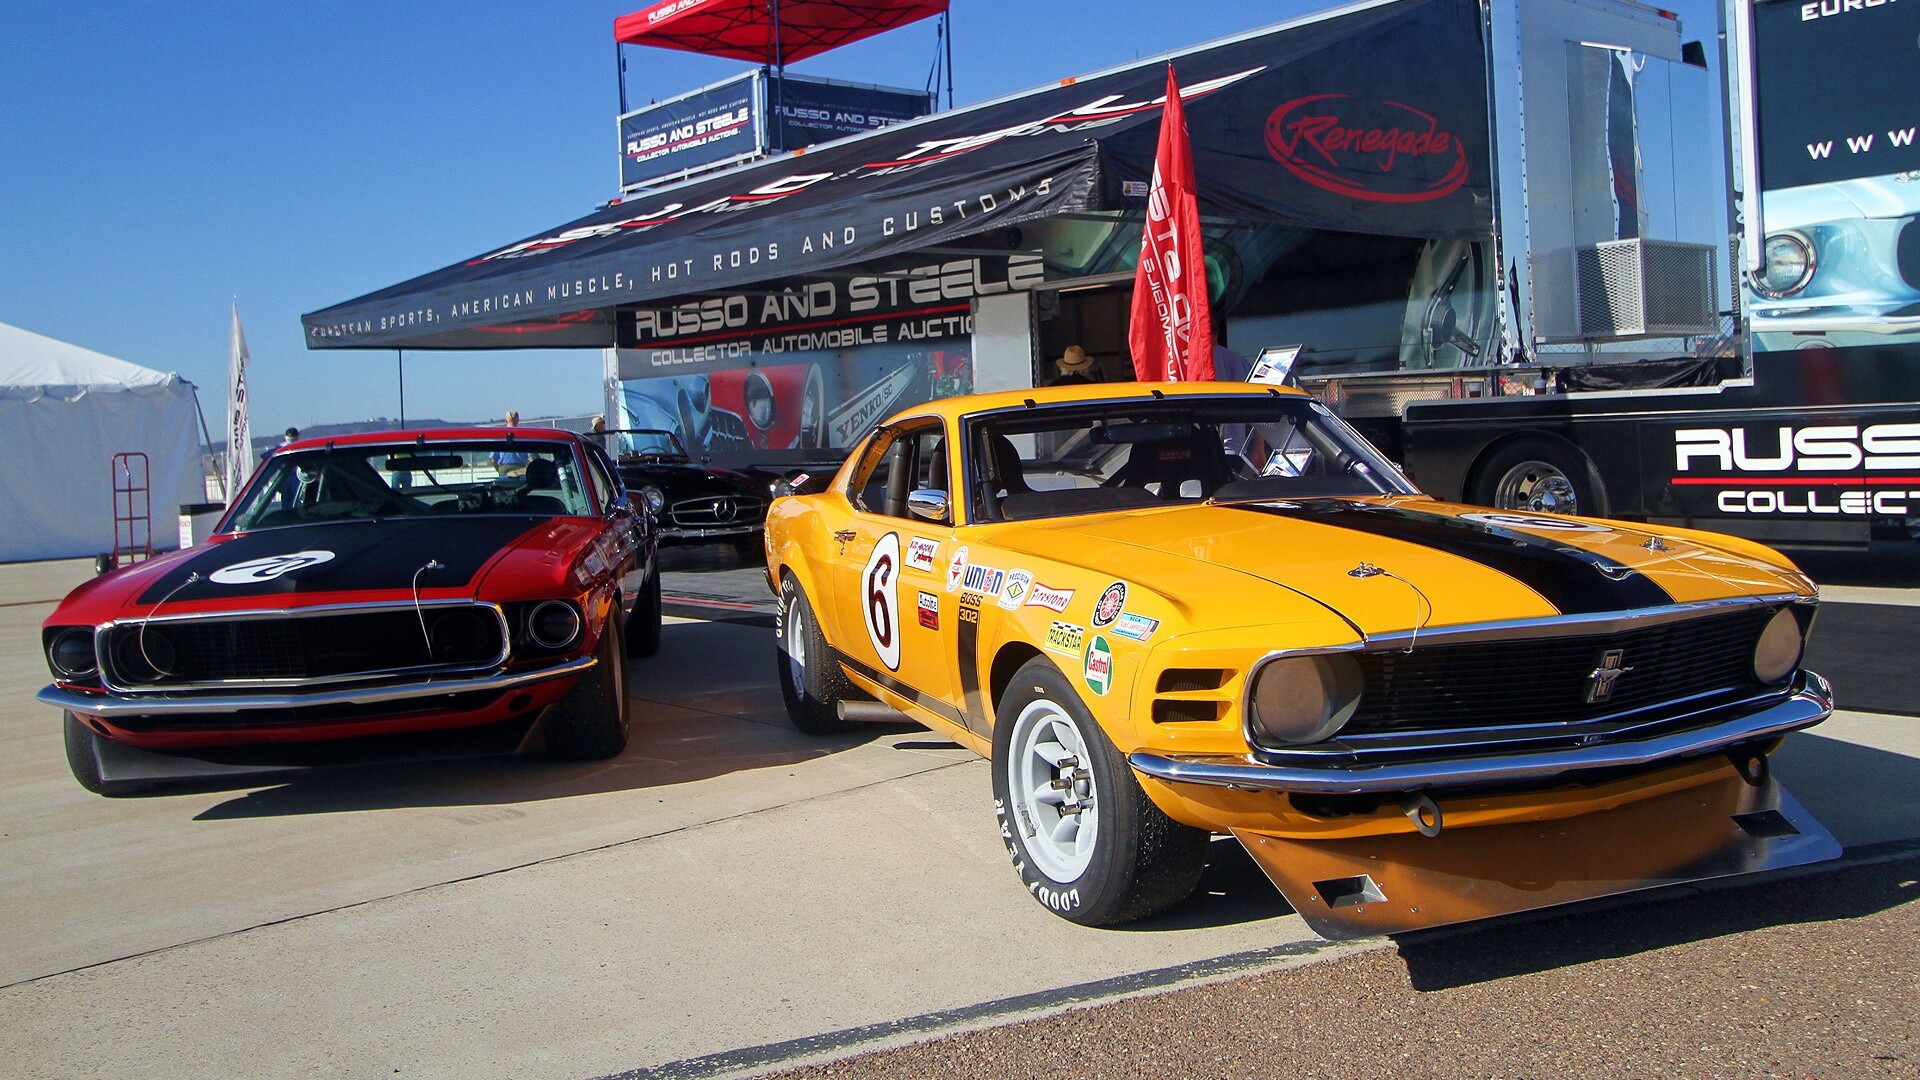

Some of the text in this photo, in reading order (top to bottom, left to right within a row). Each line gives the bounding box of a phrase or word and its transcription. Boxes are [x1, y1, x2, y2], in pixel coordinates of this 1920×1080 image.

[1801, 0, 1901, 22] EUR
[775, 104, 830, 121] RUSSO
[835, 112, 865, 124] AND
[788, 120, 833, 130] COLLECTOR
[627, 132, 667, 155] RUSSO
[669, 125, 694, 143] AND
[696, 107, 749, 136] STEELE
[1286, 115, 1450, 172] Renegade
[636, 148, 670, 163] COLLECTOR
[671, 137, 707, 154] AUTOMOBILE
[381, 310, 441, 331] SPORTS,
[451, 290, 533, 318] AMERICAN
[548, 272, 634, 301] MUSCLE,
[651, 259, 693, 282] HOT
[713, 243, 778, 271] RODS
[803, 226, 856, 254] AND
[883, 178, 1053, 236] CUSTOMS
[635, 250, 1045, 340] RUSSO AND STEELE
[651, 341, 752, 367] COLLECTOR
[762, 325, 888, 355] AUTOMOBILE
[1675, 423, 1920, 471] RUSS
[868, 553, 892, 649] 6
[960, 592, 984, 607] BOSS
[1030, 588, 1068, 608] Firestone
[959, 608, 978, 624] 302
[1047, 629, 1082, 651] TRACKSTAR
[1089, 650, 1110, 675] Castrol
